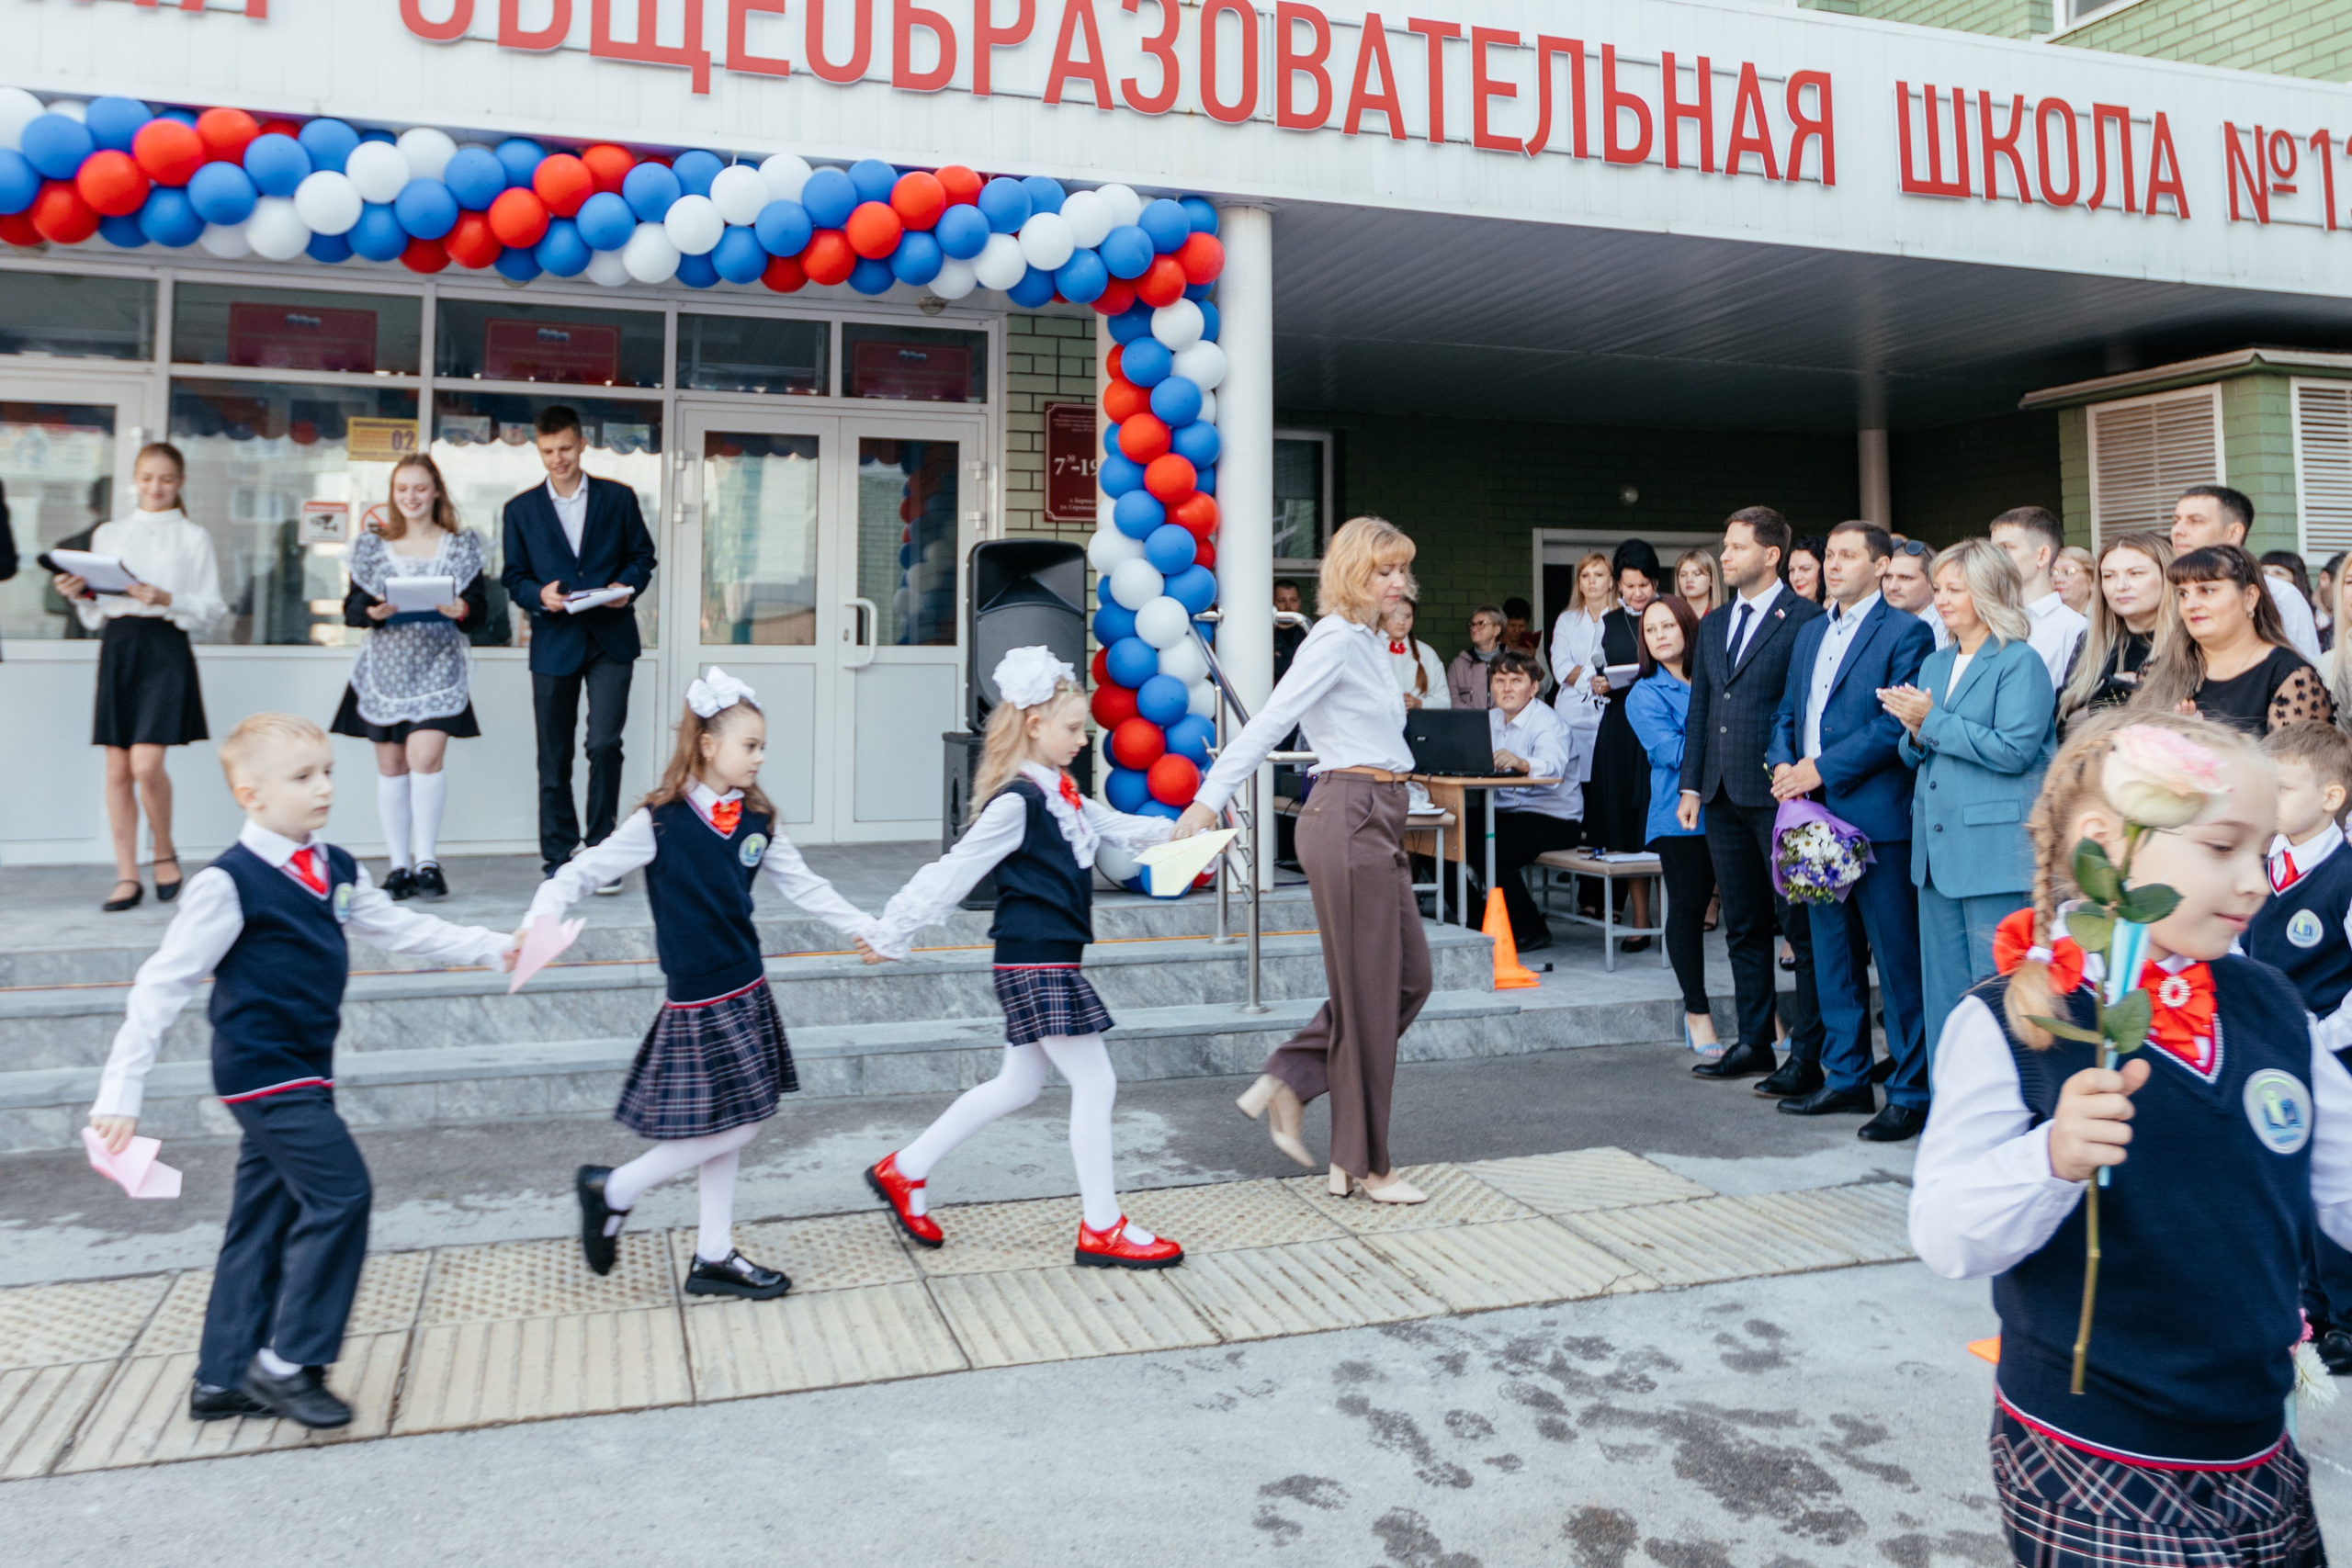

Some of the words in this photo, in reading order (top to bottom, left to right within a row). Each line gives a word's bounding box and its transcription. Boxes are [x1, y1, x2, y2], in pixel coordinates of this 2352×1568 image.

[1895, 80, 2190, 220] ШКОЛА
[2223, 120, 2352, 231] №1
[392, 430, 415, 451] 02
